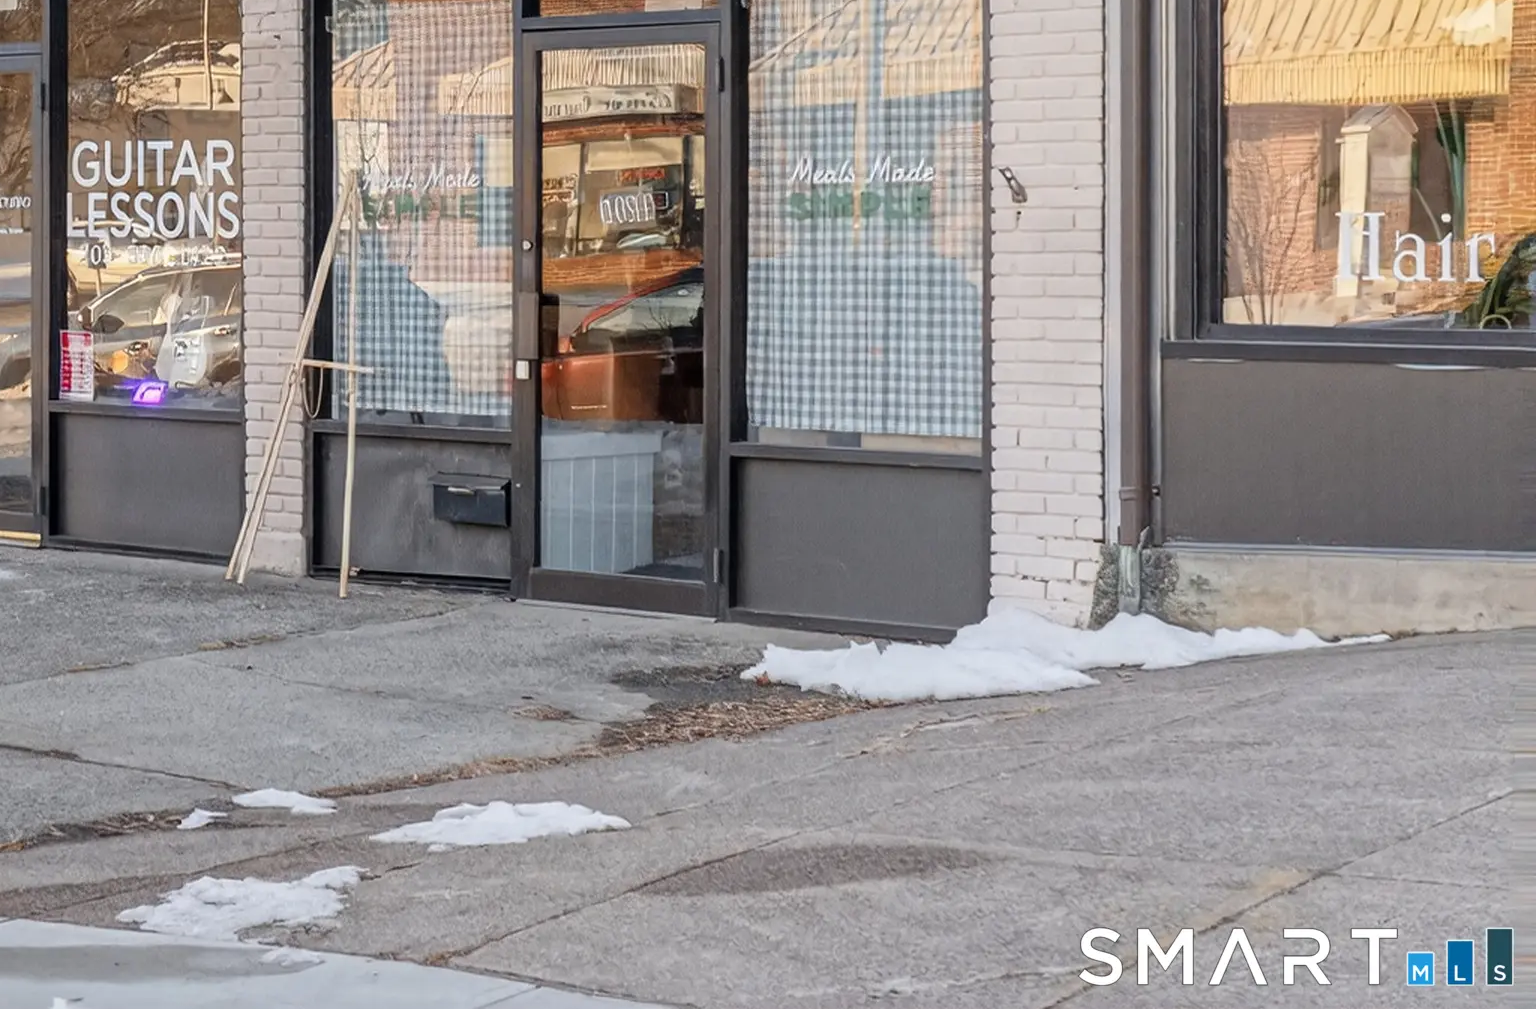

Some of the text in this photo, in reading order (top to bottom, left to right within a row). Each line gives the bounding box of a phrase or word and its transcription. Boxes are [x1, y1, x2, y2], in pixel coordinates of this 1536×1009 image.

[72, 139, 235, 188] GUITAR
[787, 153, 936, 184] Meals Made
[66, 191, 240, 240] LESSONS
[1335, 211, 1496, 283] Hair
